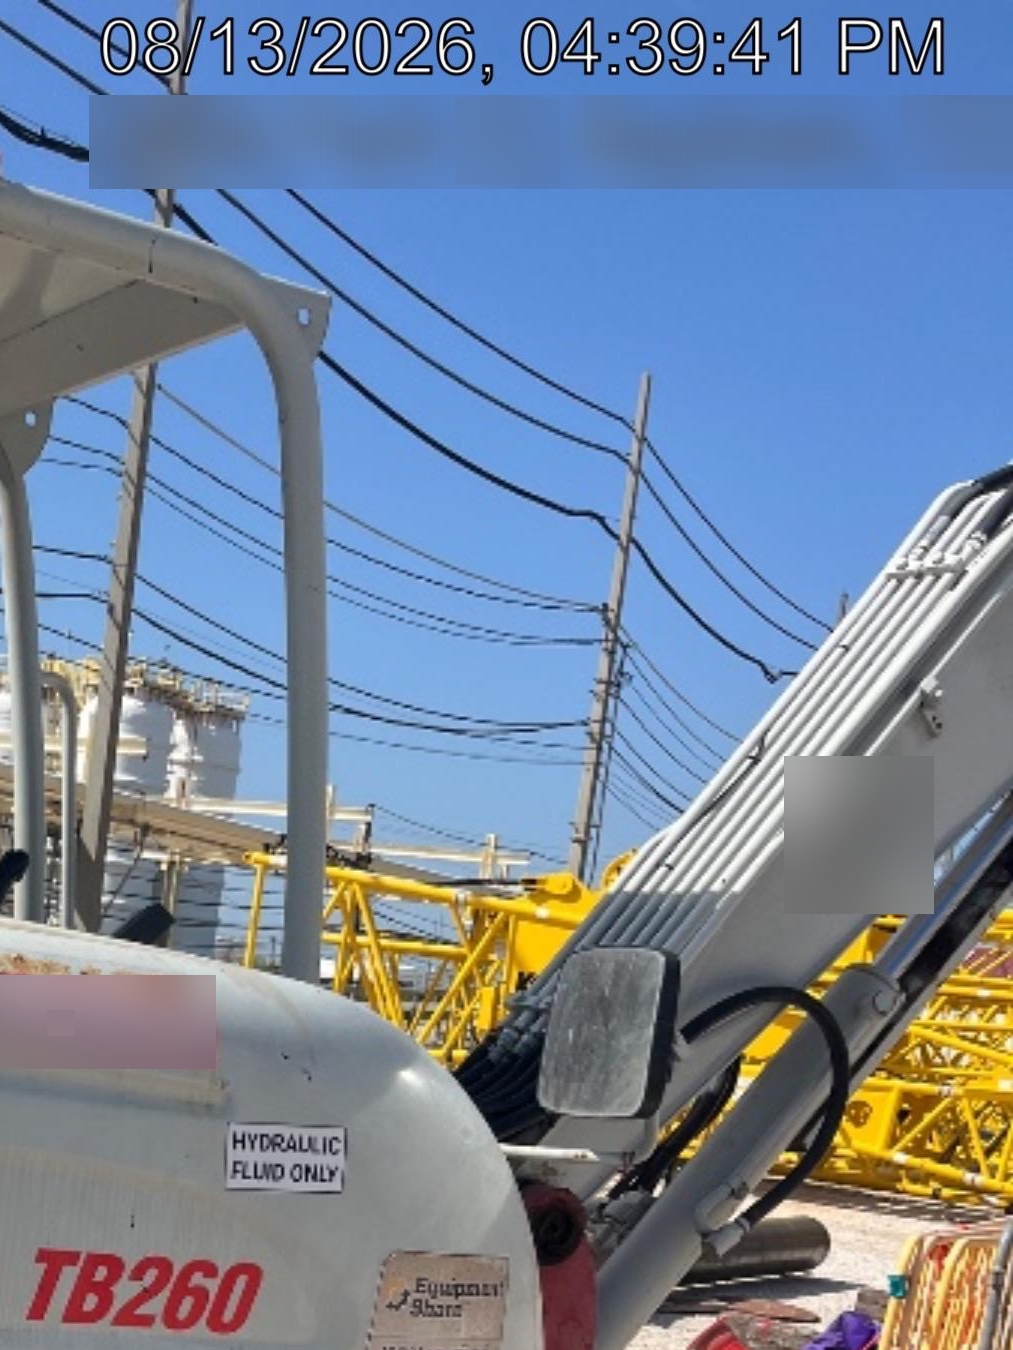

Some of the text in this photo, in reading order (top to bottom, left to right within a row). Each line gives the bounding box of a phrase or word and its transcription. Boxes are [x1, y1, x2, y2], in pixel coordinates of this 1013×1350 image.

[232, 1131, 341, 1156] HYDRAULIC
[231, 1160, 339, 1184] FLUID ONLY
[26, 1247, 263, 1334] TB260
